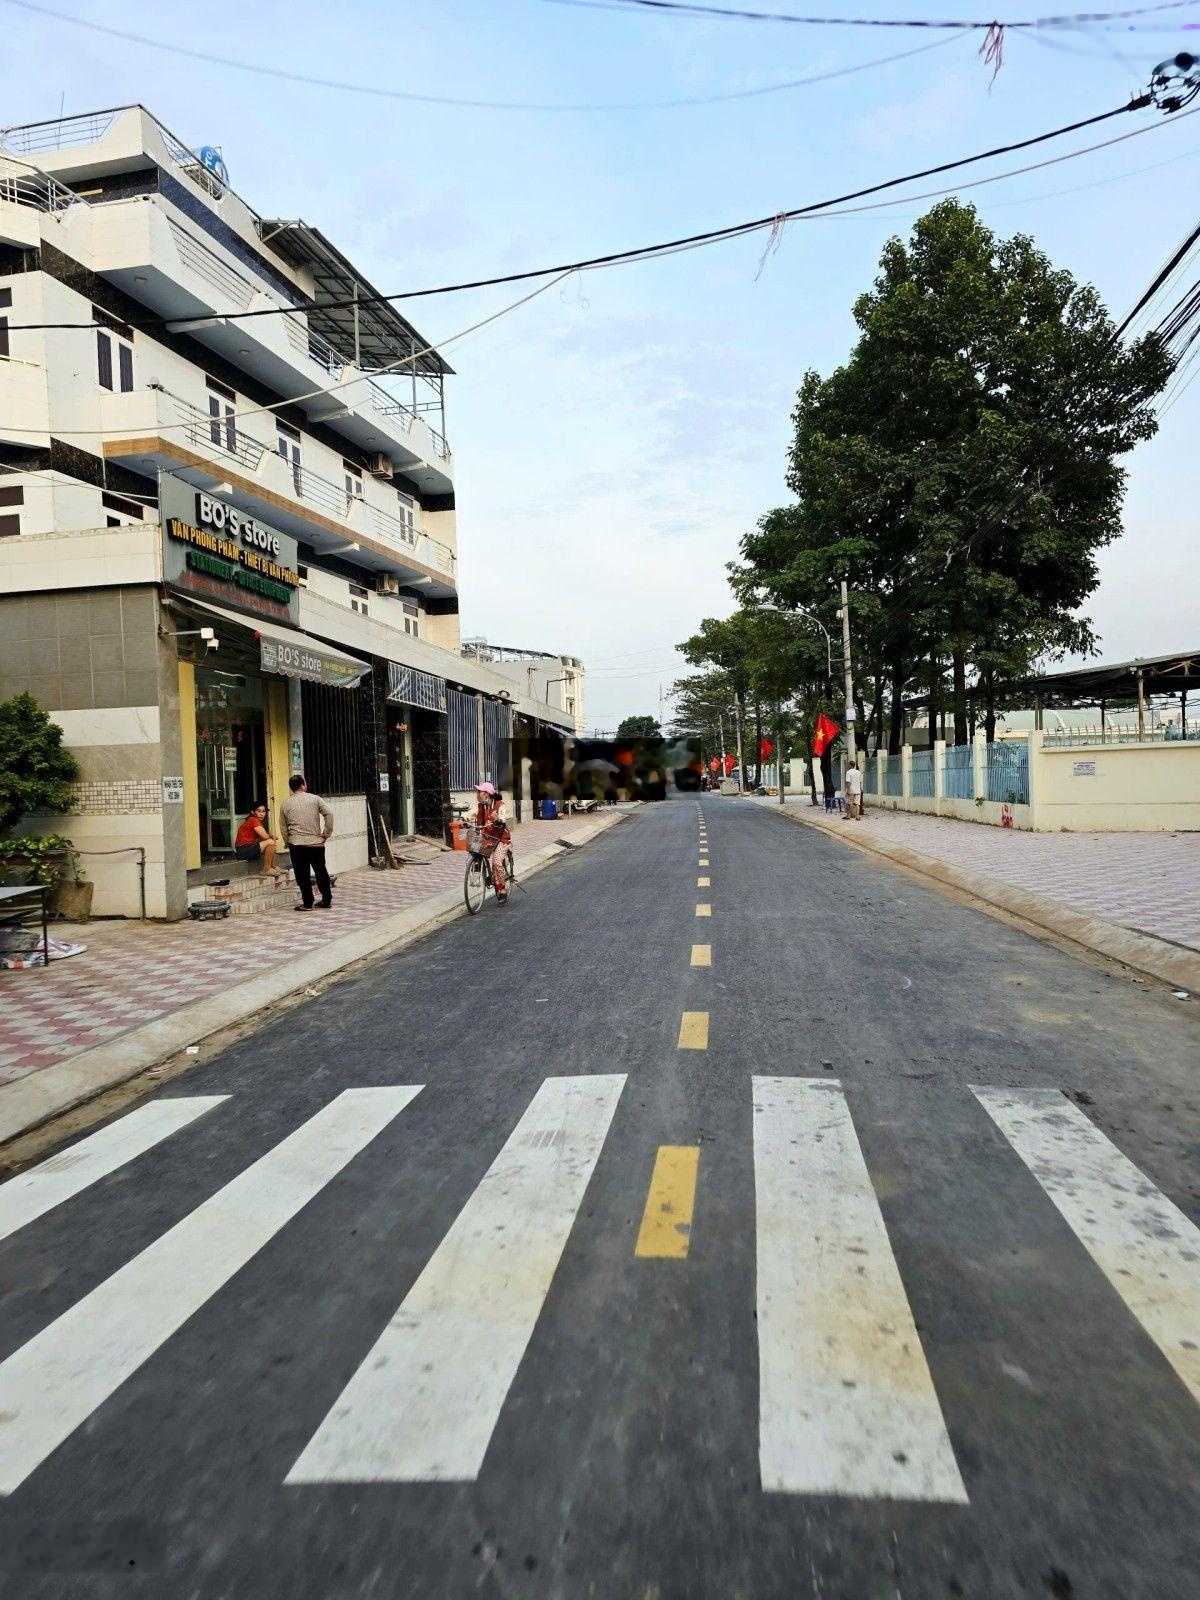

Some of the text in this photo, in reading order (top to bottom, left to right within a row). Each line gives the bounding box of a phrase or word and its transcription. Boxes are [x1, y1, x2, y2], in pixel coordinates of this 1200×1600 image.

[198, 494, 280, 556] BO'S store
[278, 644, 299, 667] BO'S
[301, 652, 322, 672] store
